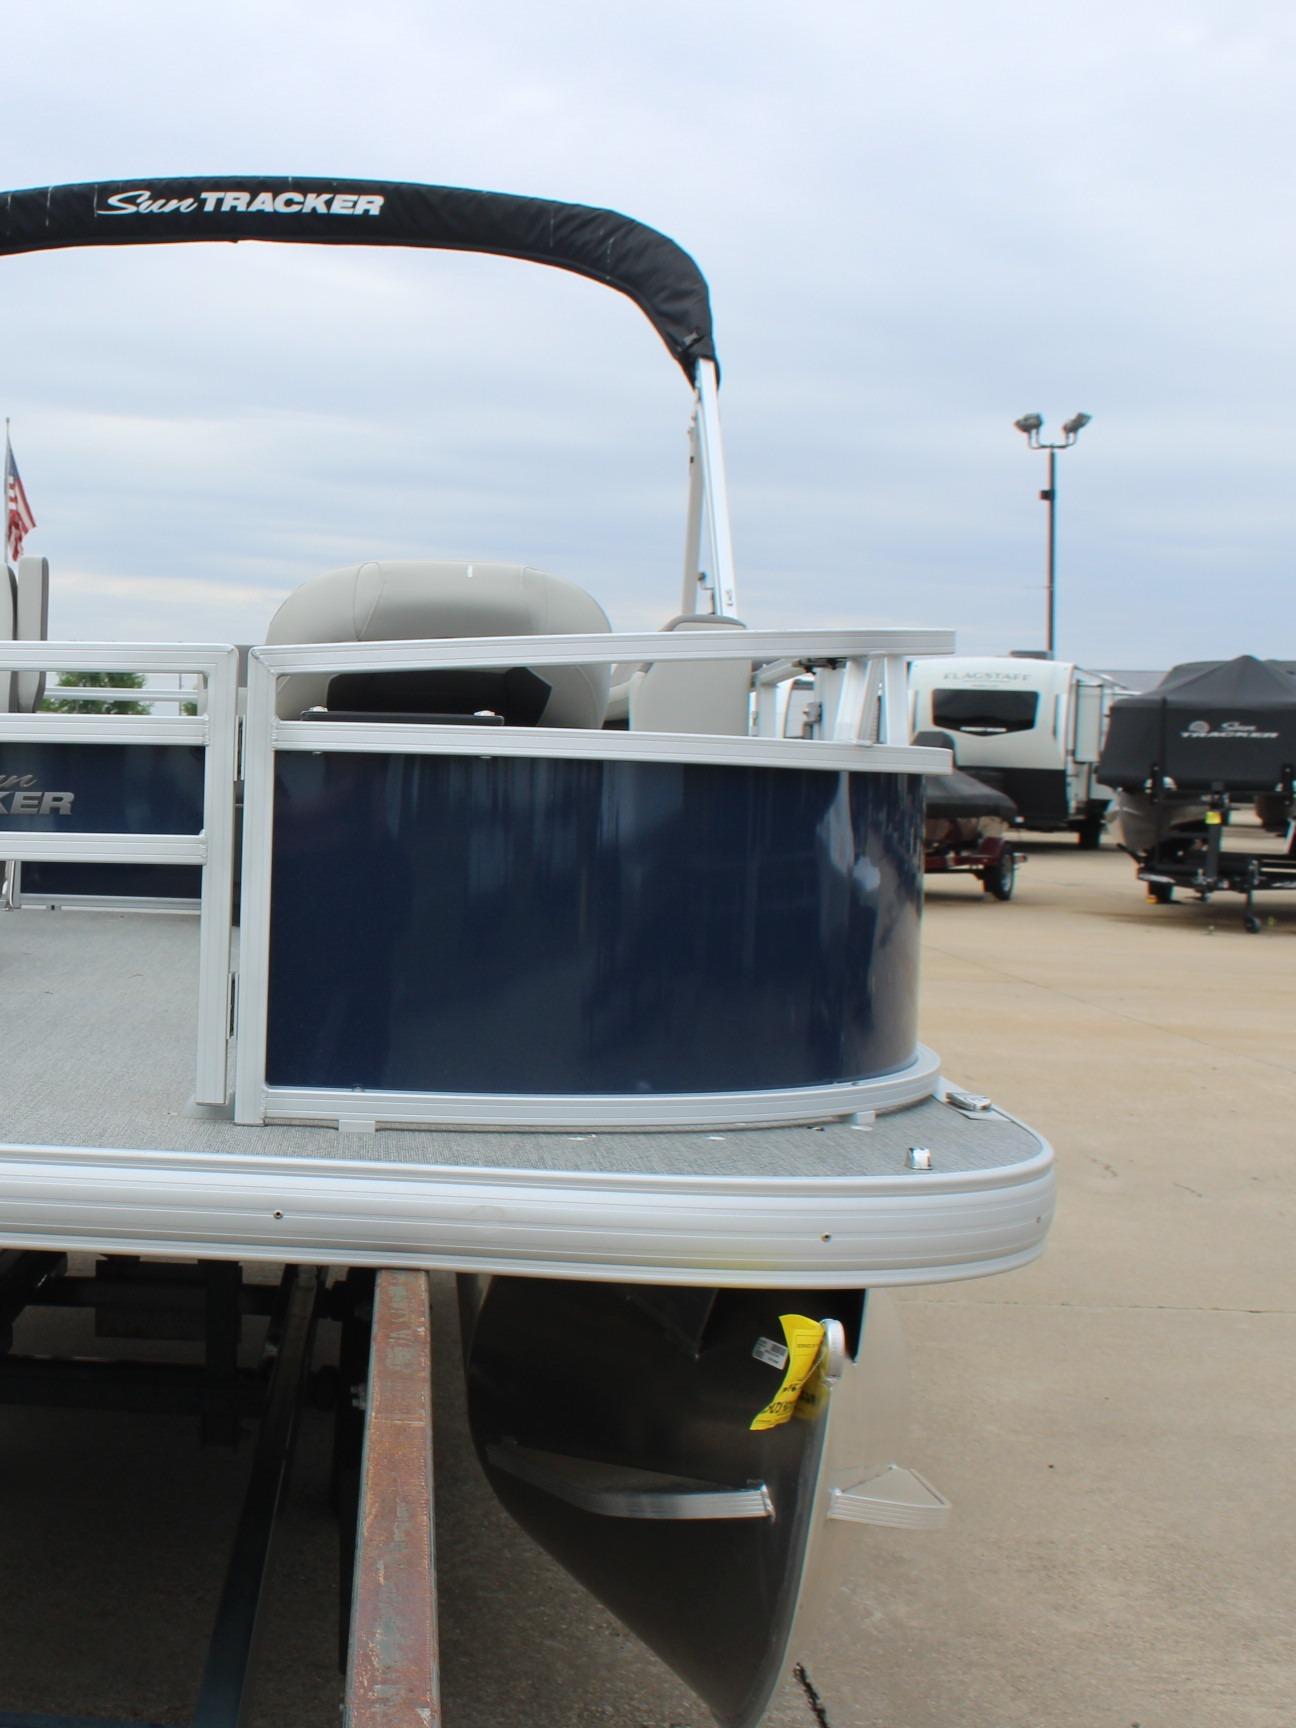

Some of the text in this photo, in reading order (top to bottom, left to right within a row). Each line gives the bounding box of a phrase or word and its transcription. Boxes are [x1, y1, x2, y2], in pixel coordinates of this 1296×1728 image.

[94, 189, 385, 216] Sun TRACKER
[943, 671, 1032, 681] FLAGSTAFF
